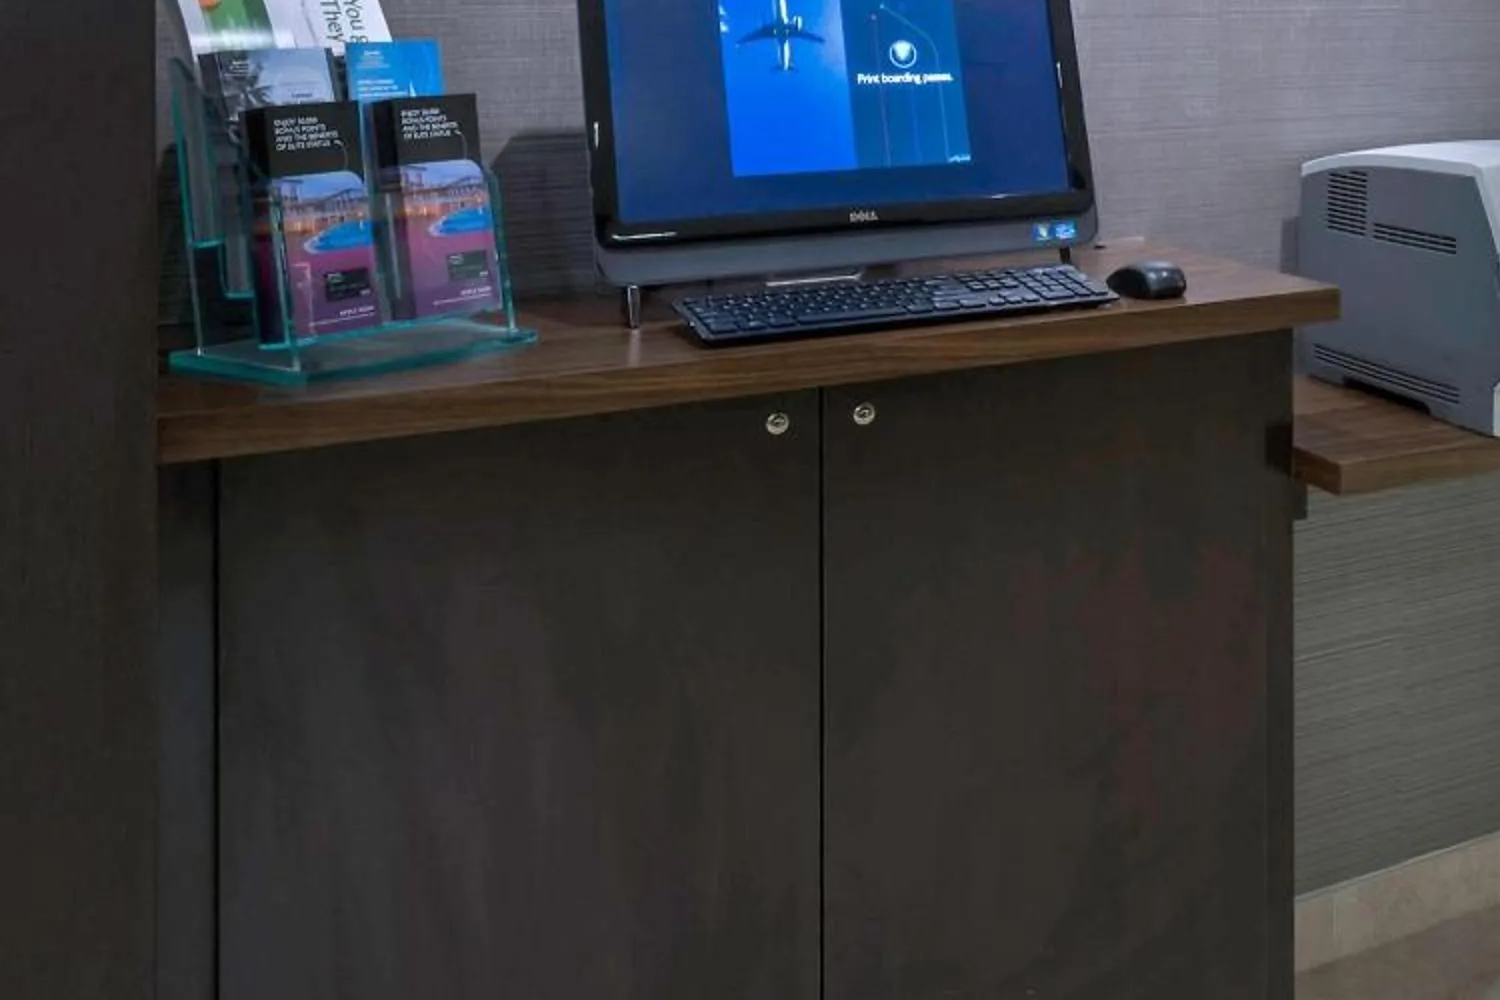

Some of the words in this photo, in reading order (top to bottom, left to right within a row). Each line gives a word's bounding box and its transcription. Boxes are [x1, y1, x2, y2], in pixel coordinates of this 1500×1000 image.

[857, 73, 880, 84] Print
[881, 72, 921, 85] boarding
[849, 208, 878, 223] DELL
